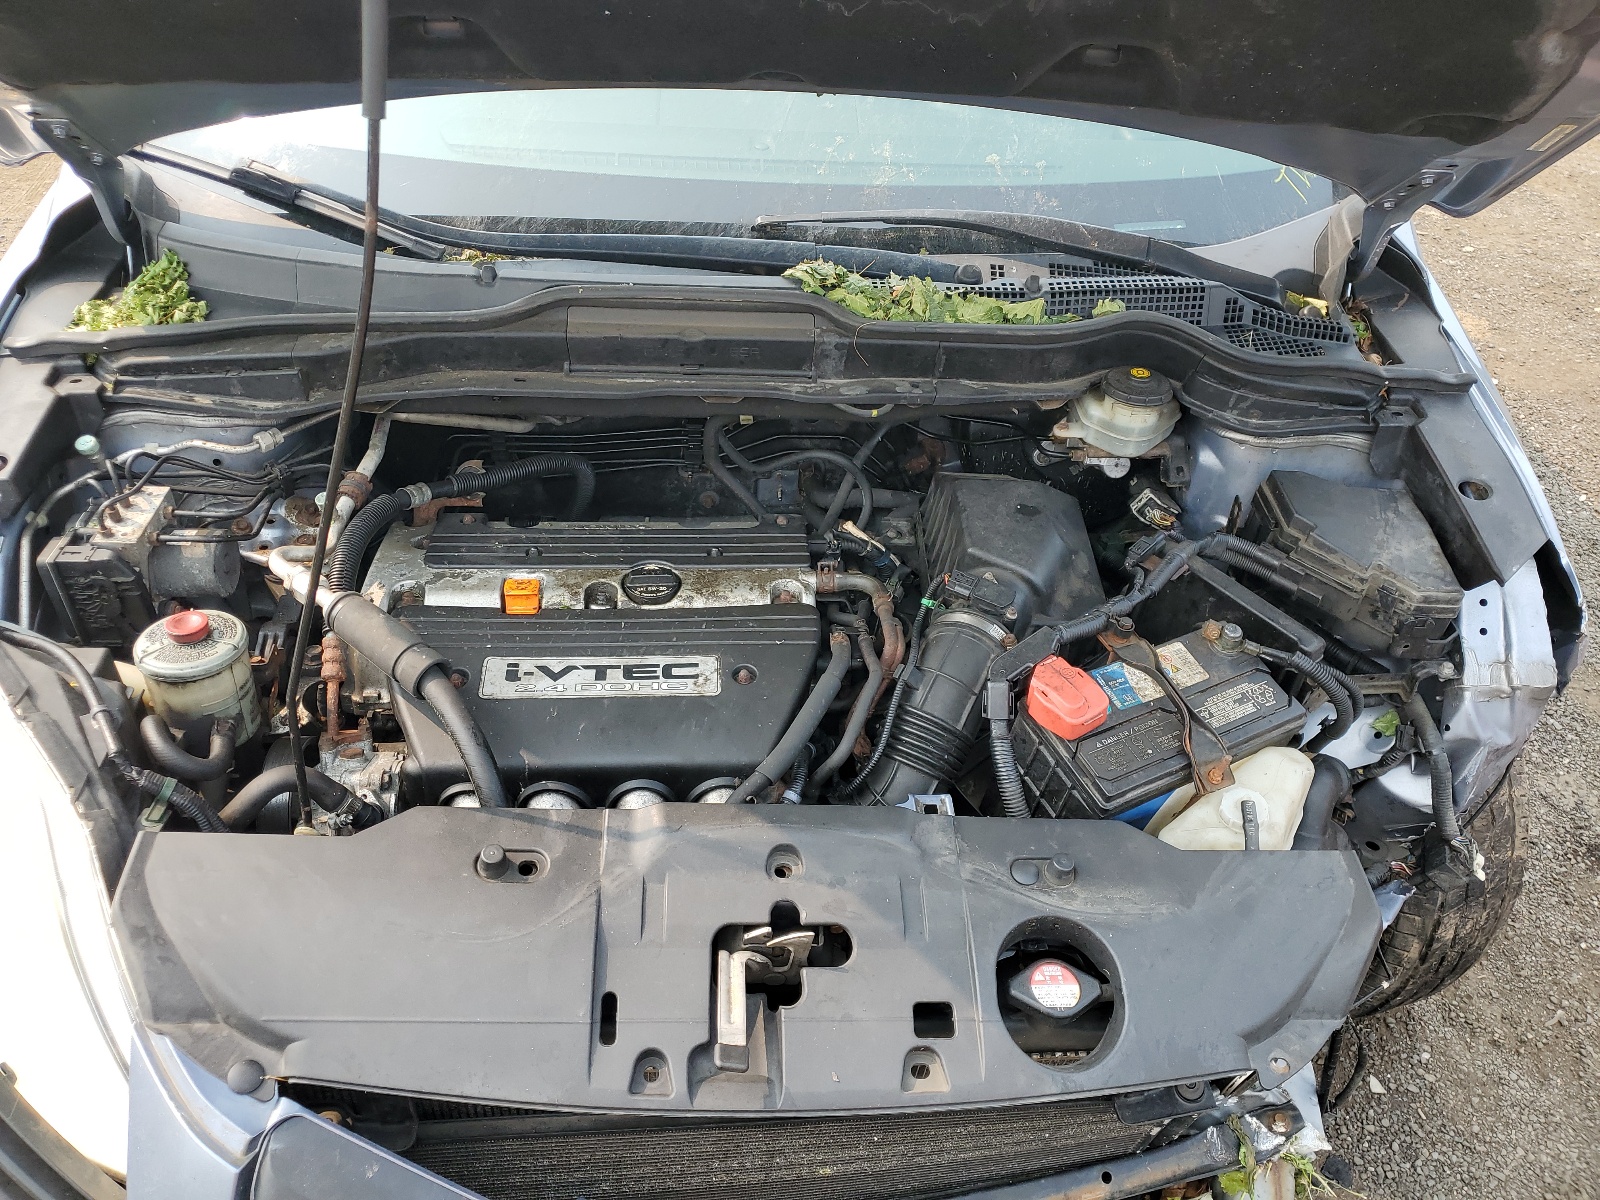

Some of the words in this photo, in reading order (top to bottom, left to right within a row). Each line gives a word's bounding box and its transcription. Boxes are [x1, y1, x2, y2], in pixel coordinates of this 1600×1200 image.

[505, 663, 700, 682] i-VTEC
[515, 683, 567, 693] 2.4
[575, 682, 688, 692] DOHC
[1102, 730, 1129, 745] DANGER
